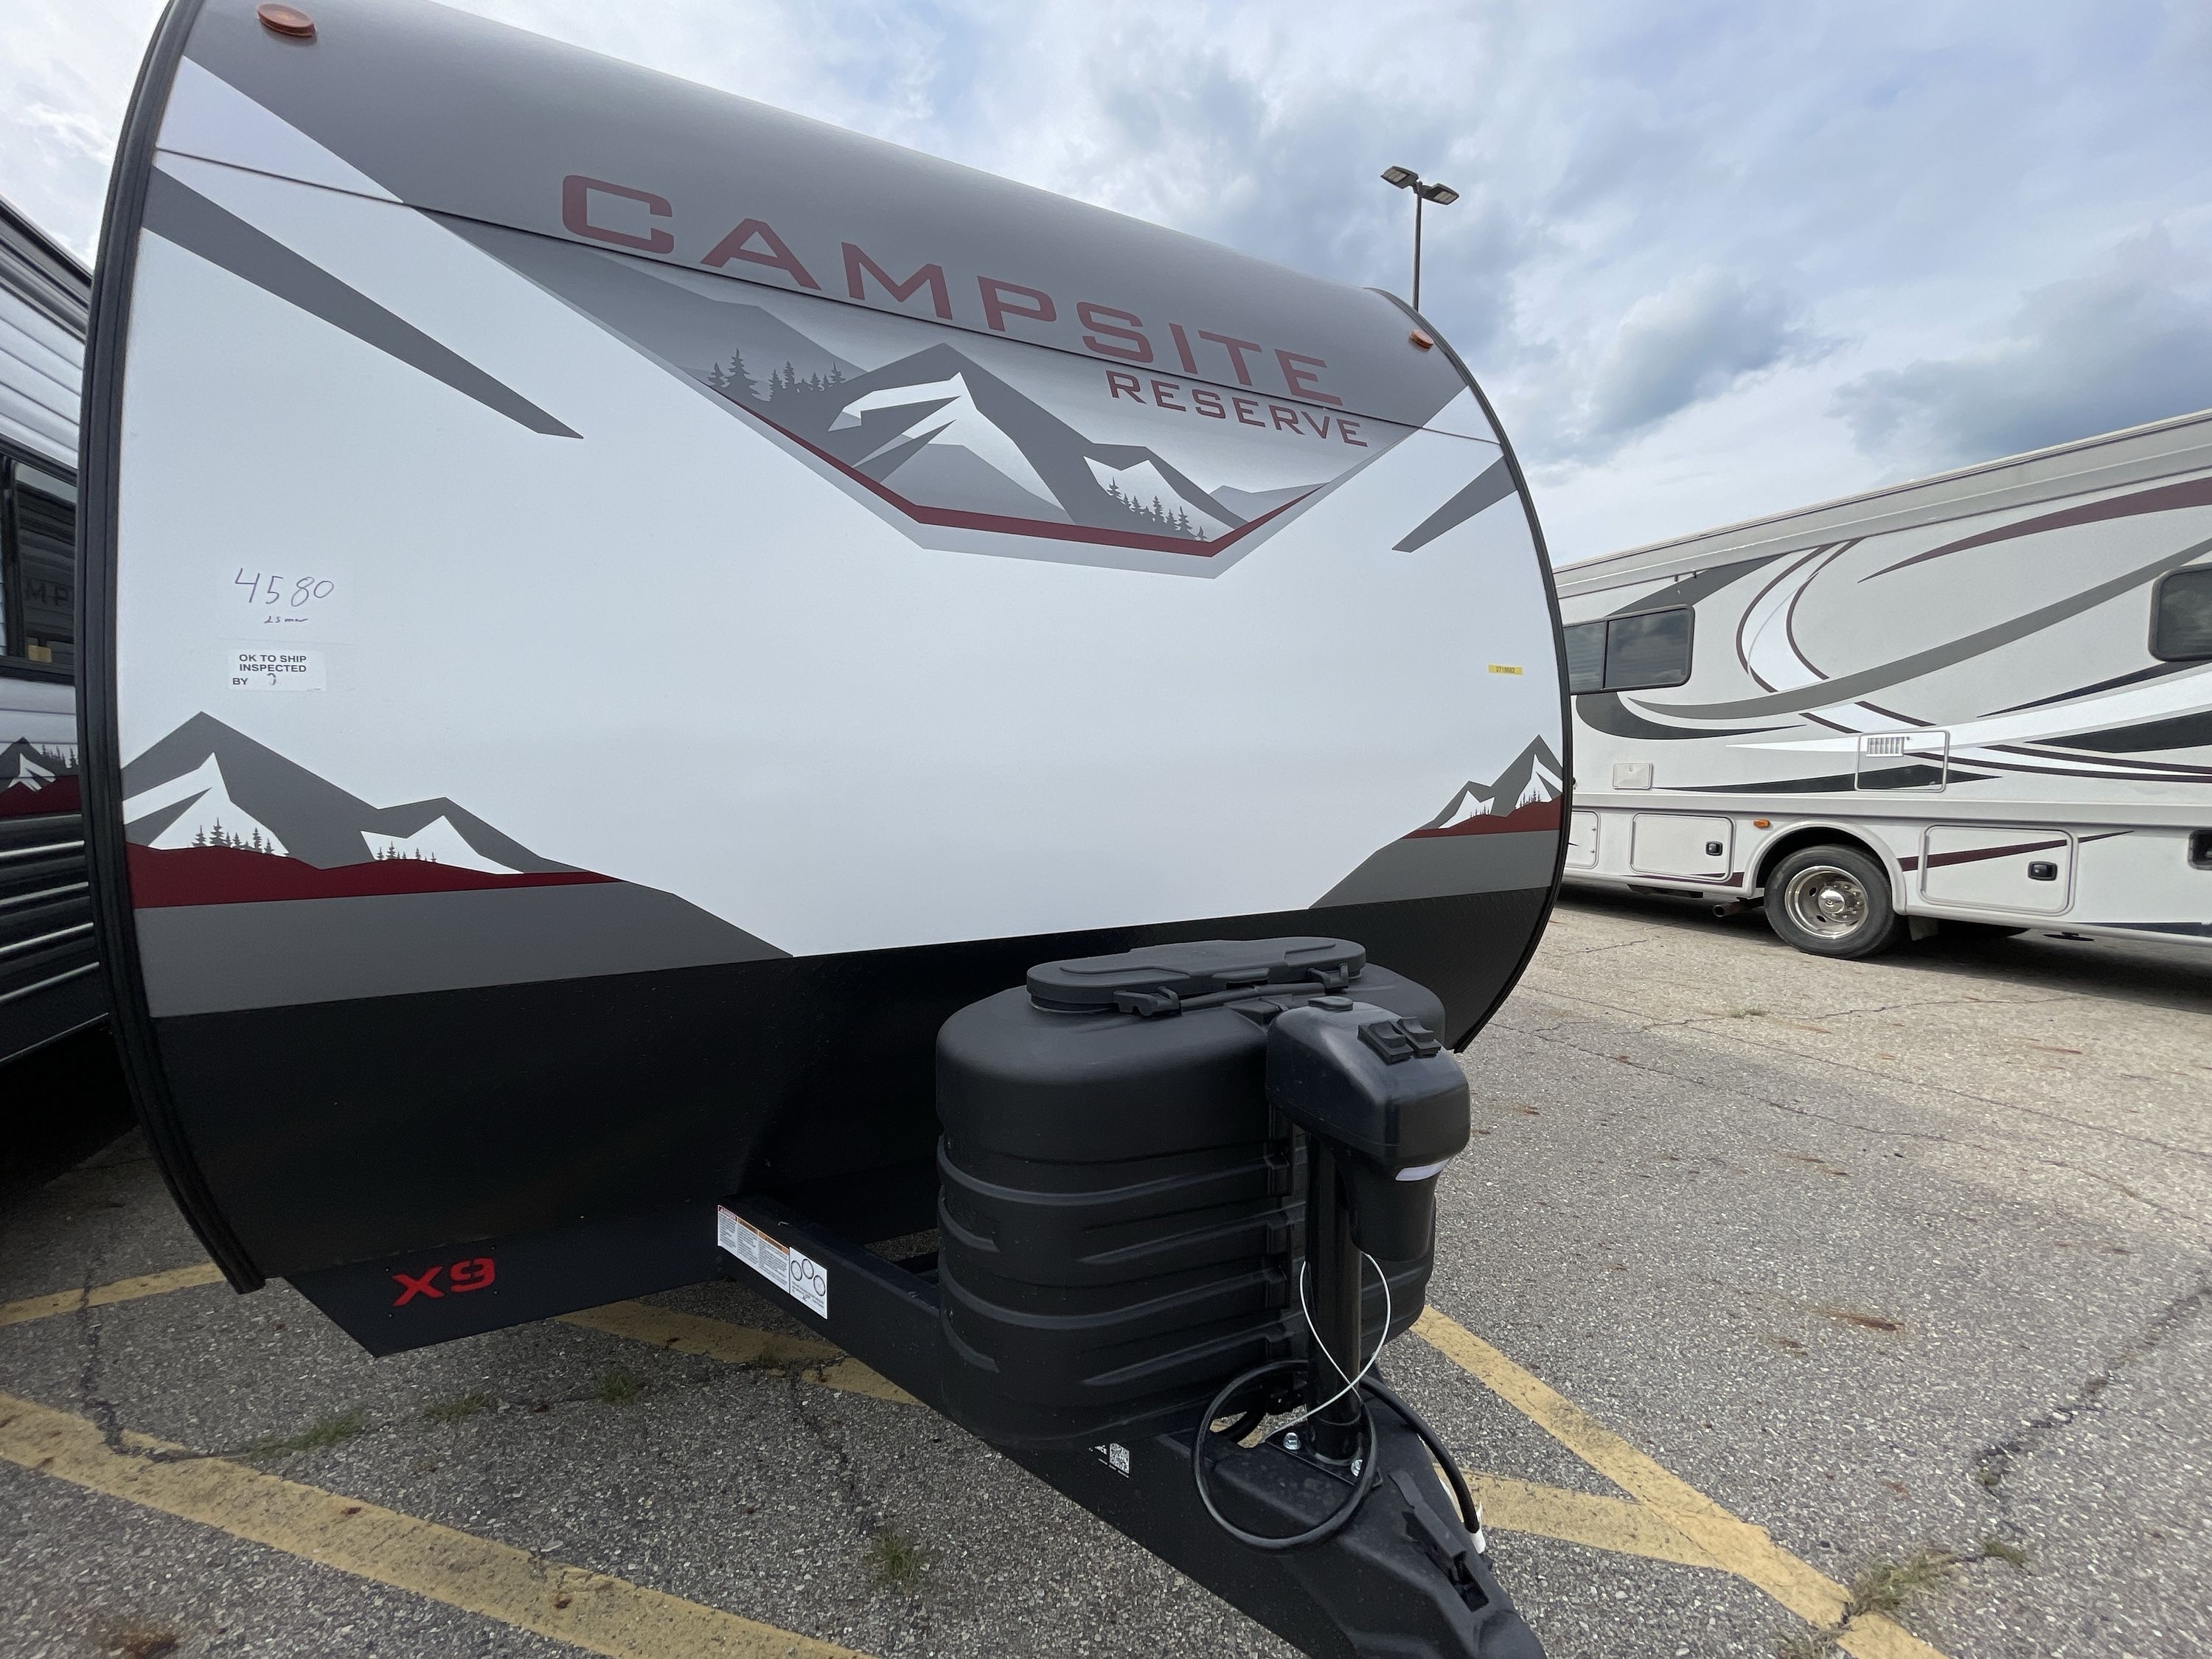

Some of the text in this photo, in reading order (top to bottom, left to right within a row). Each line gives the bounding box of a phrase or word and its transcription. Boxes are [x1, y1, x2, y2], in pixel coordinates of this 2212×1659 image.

[562, 174, 1343, 406] CAMPSITE
[1107, 369, 1368, 448] RESERVE
[234, 568, 334, 607] 4580
[239, 664, 307, 672] INSPECTED
[392, 1257, 495, 1307] X9
